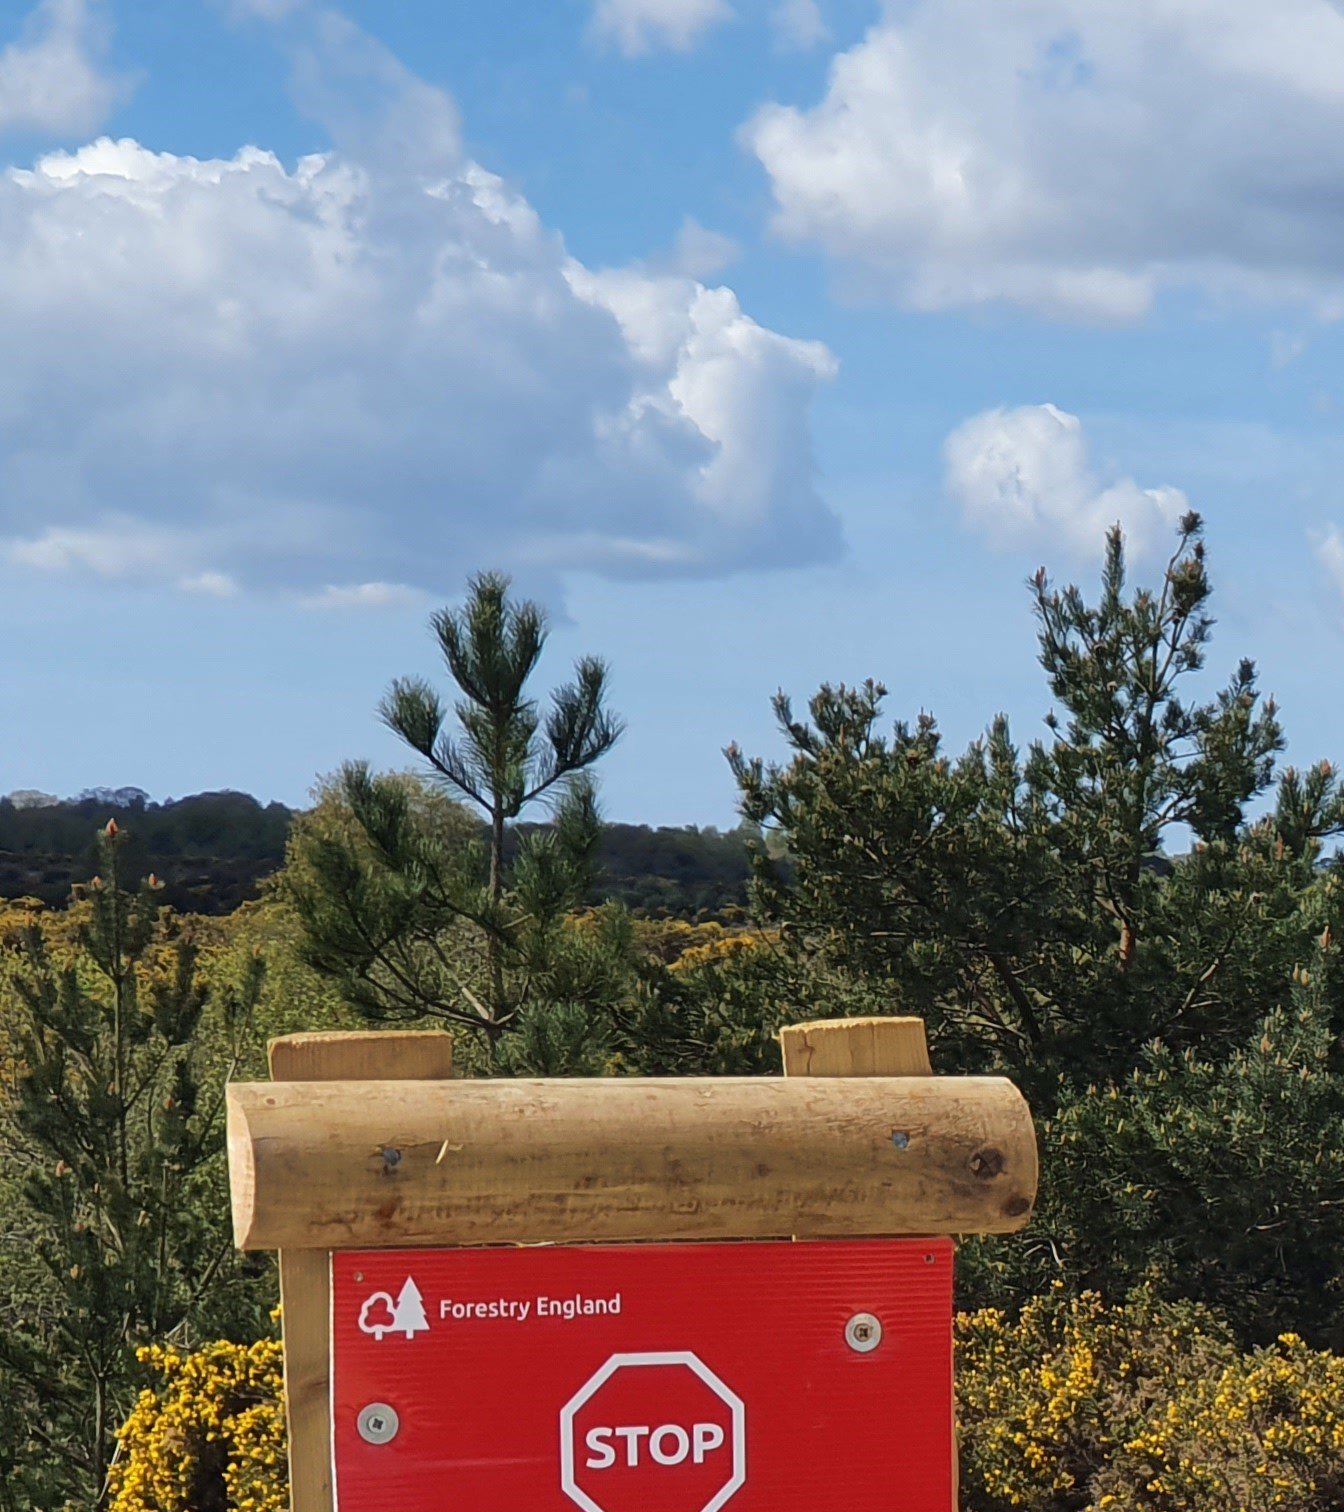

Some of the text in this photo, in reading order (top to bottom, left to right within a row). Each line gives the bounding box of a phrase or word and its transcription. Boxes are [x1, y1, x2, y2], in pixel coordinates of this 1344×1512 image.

[439, 1293, 621, 1321] Forestry England
[586, 1423, 724, 1469] STOP
